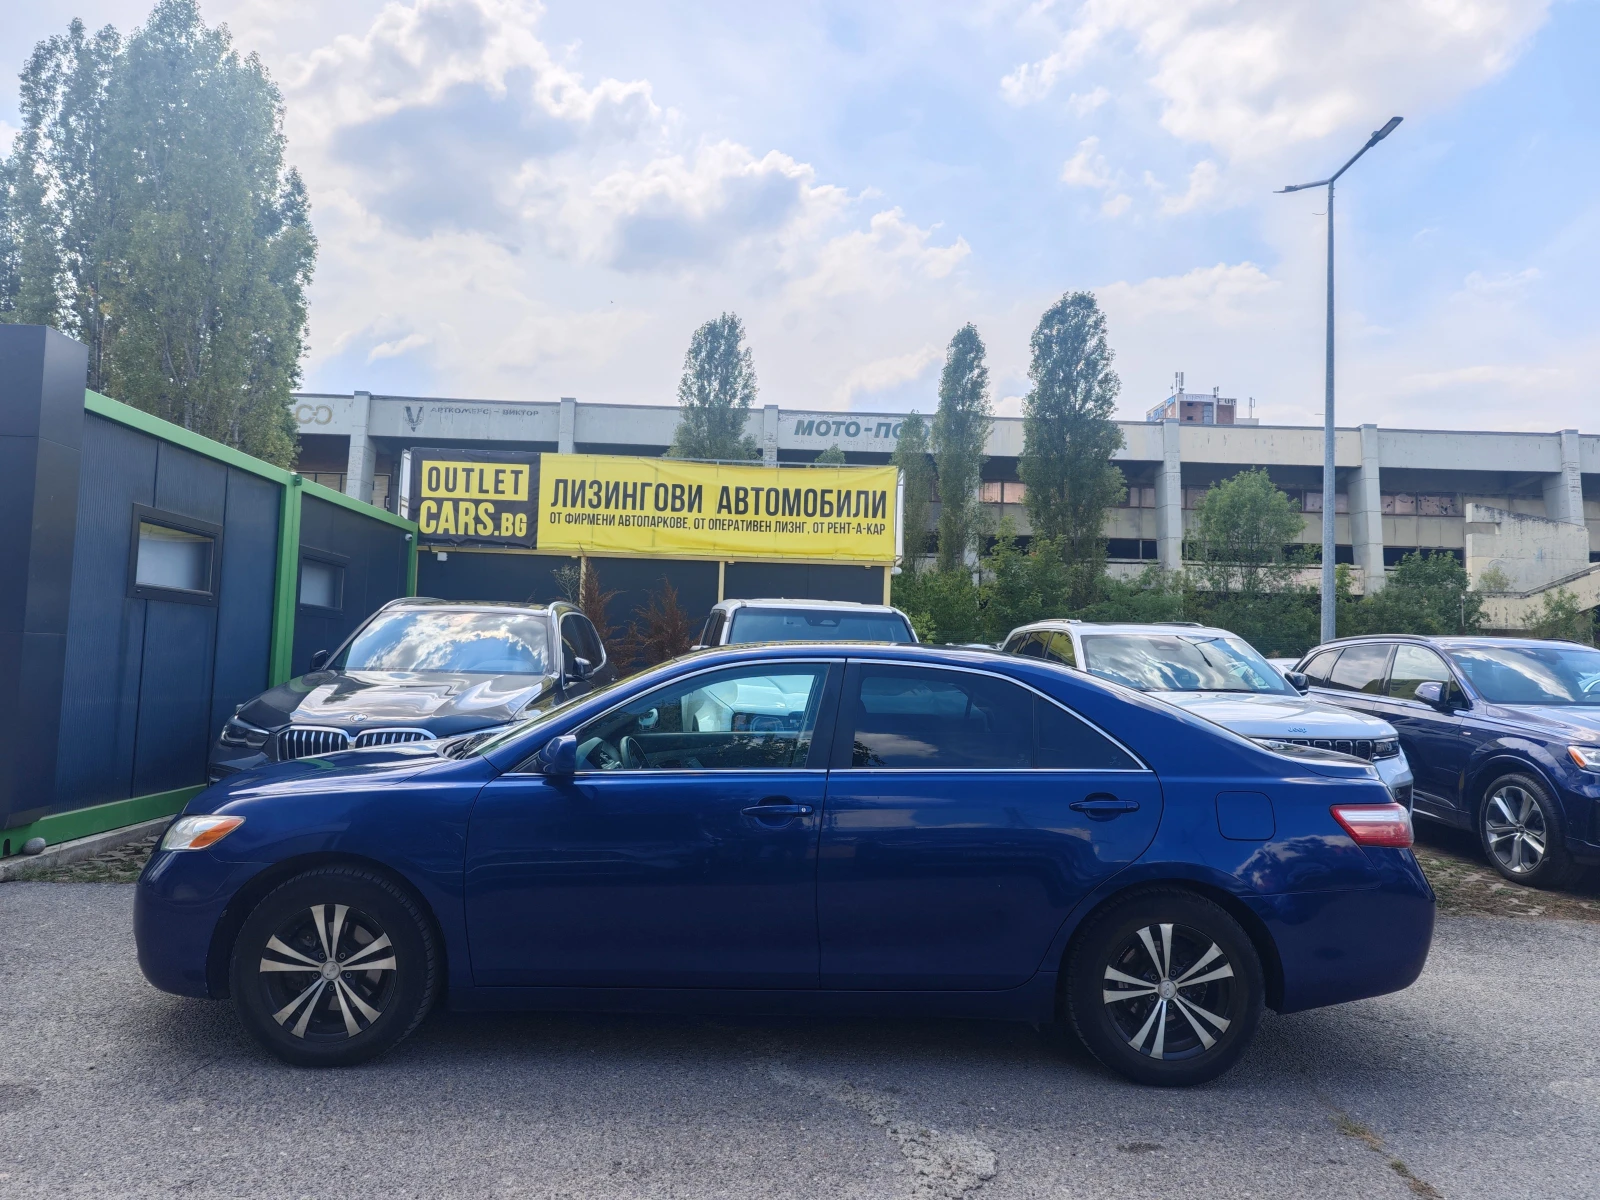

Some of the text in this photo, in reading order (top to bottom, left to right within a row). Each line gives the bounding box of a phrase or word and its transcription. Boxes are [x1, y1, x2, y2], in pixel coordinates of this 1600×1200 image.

[502, 408, 539, 417] ВИКТОР
[427, 466, 523, 495] OUTLET
[550, 478, 887, 519] ЛИЗИНГОВИ АВТОМОБИЛИ
[419, 500, 527, 537] CARS.BG
[550, 512, 562, 524] ОТ
[564, 512, 615, 526] ФИРМЕНИ
[618, 514, 691, 530] АВТОПАРКОВЕ,
[693, 517, 706, 530] ОТ
[708, 518, 771, 532] ОПЕРАТИВЕН
[812, 522, 825, 534] ОТ
[827, 522, 886, 535] РЕНТ-А-КАР
